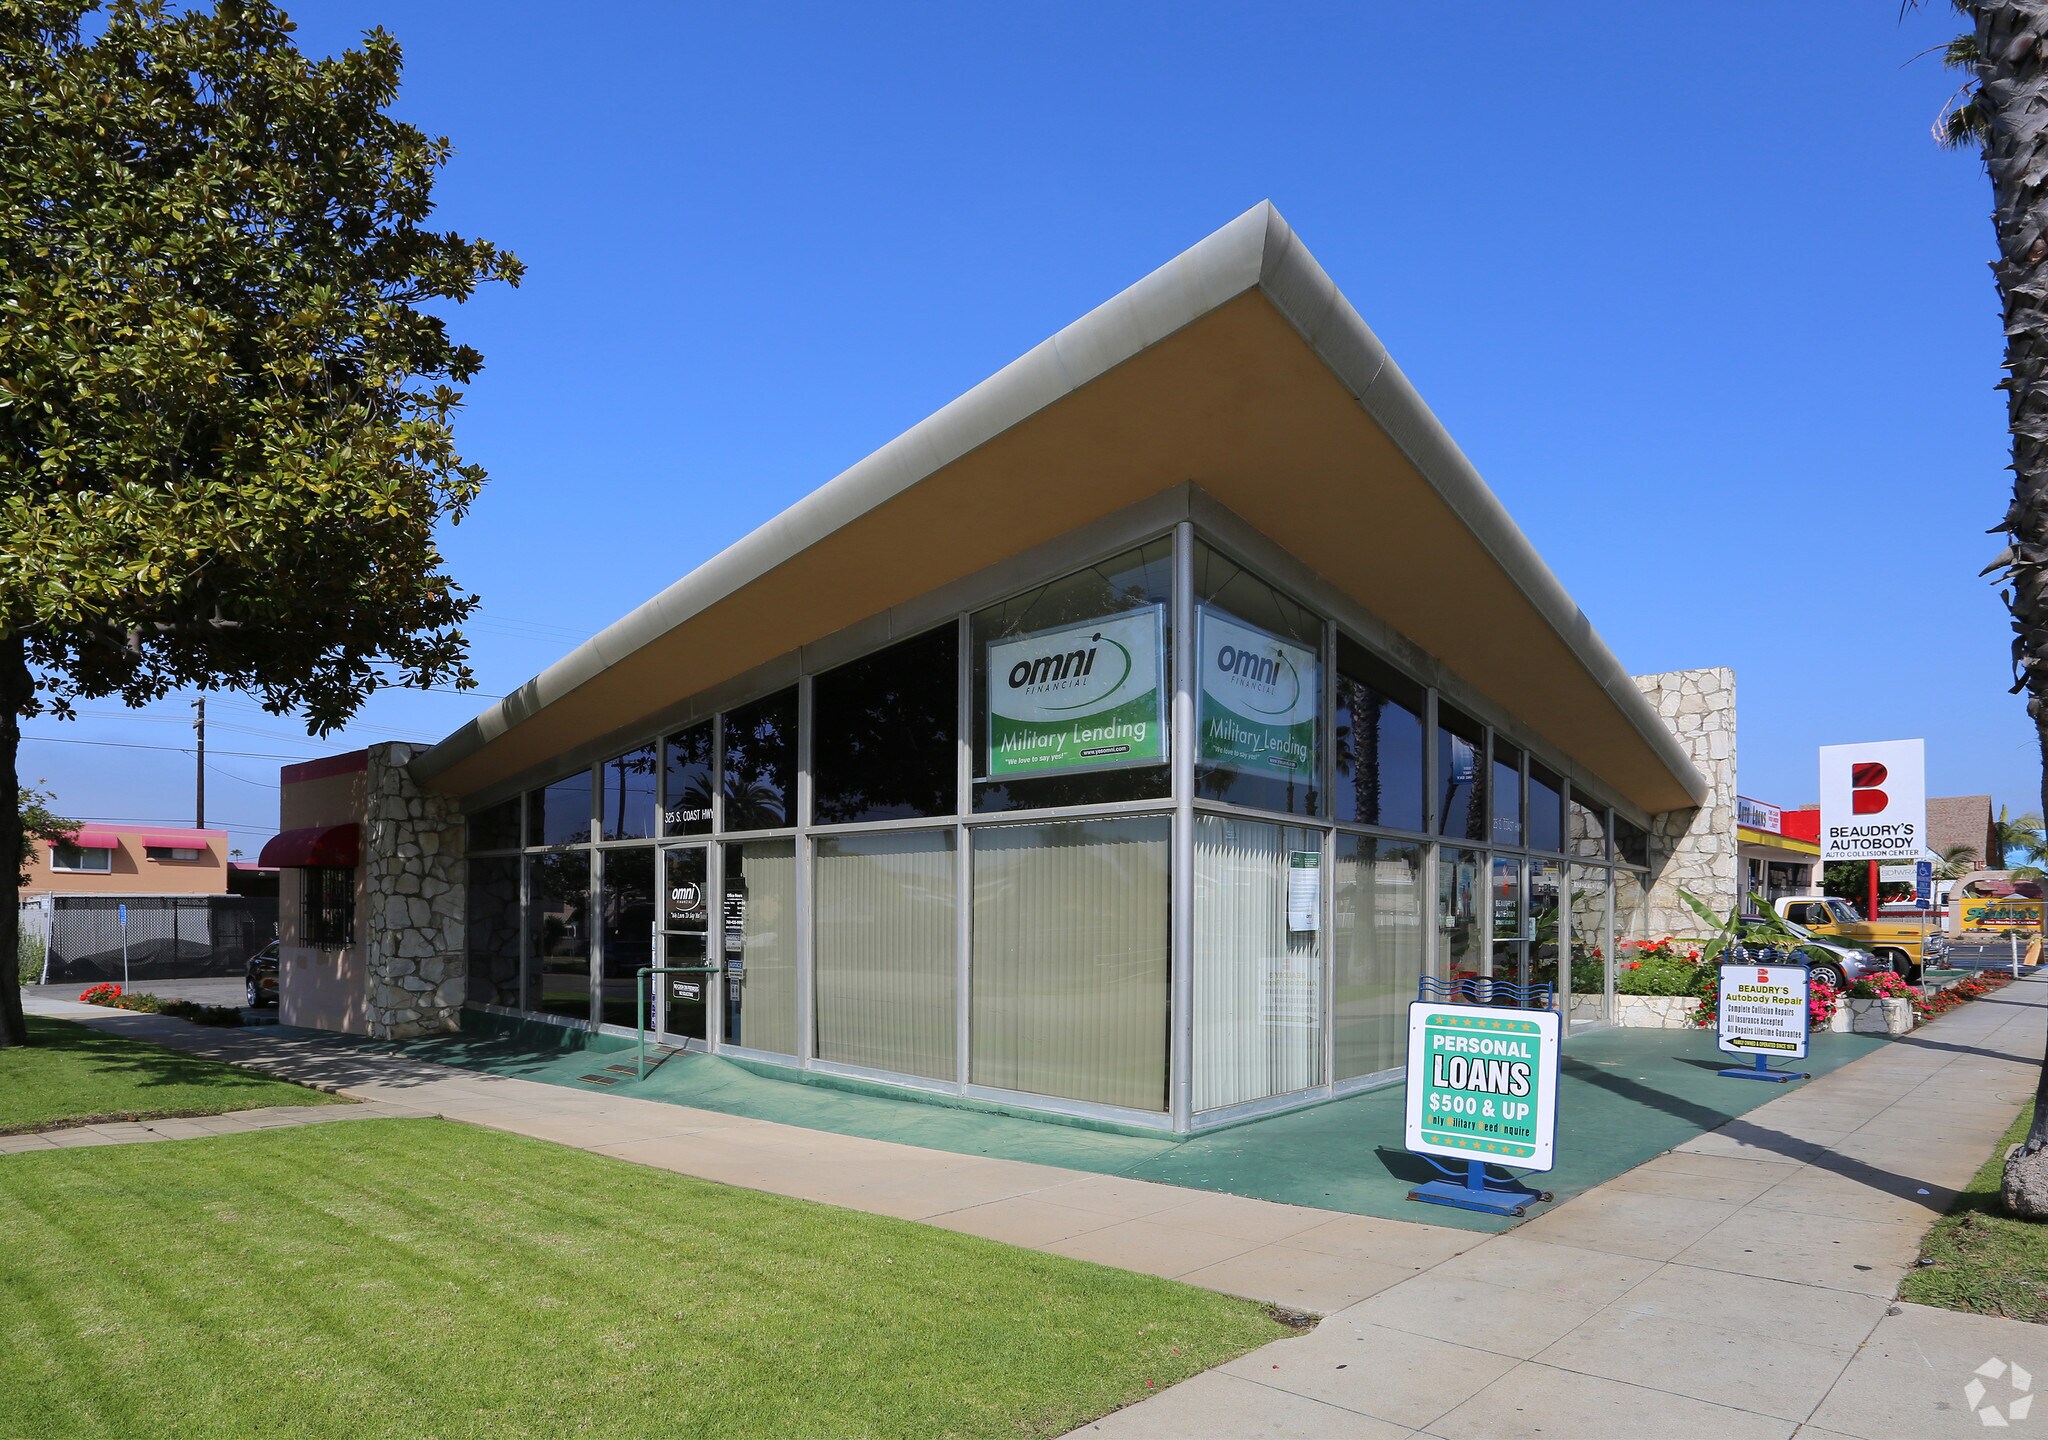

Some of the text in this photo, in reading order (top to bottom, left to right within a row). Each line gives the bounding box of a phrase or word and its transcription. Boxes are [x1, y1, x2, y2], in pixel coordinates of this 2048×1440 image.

[1008, 636, 1100, 689] omni
[1218, 646, 1282, 686] omni
[1025, 678, 1087, 695] FINANCIAL
[1231, 678, 1275, 695] FINANCIAL
[1001, 717, 1146, 752] Military Lending
[1209, 717, 1308, 763] Military Lending
[665, 812, 675, 823] 325
[683, 810, 701, 821] COAST
[702, 808, 714, 820] HWY
[1830, 823, 1914, 838] BEAUDRY'S
[1830, 837, 1914, 850] AUTOBODY
[672, 885, 695, 900] omni
[1738, 984, 1789, 994] BEAUDRY'S
[1726, 993, 1803, 1006] Autobody Repair
[1728, 1004, 1794, 1016] Complete Collision Repairs
[1735, 1015, 1759, 1025] Insurance
[1760, 1017, 1783, 1026] Accepted
[1735, 1025, 1753, 1035] Repairs
[1754, 1027, 1774, 1036] Lifetime
[1775, 1029, 1802, 1038] Guarantee
[1433, 1035, 1532, 1059] PERSONAL
[1432, 1054, 1532, 1097] LOANS
[1429, 1092, 1529, 1120] $500 & UP
[1427, 1114, 1444, 1126] Only
[1446, 1116, 1476, 1130] Military
[1500, 1124, 1530, 1137] Inquire
